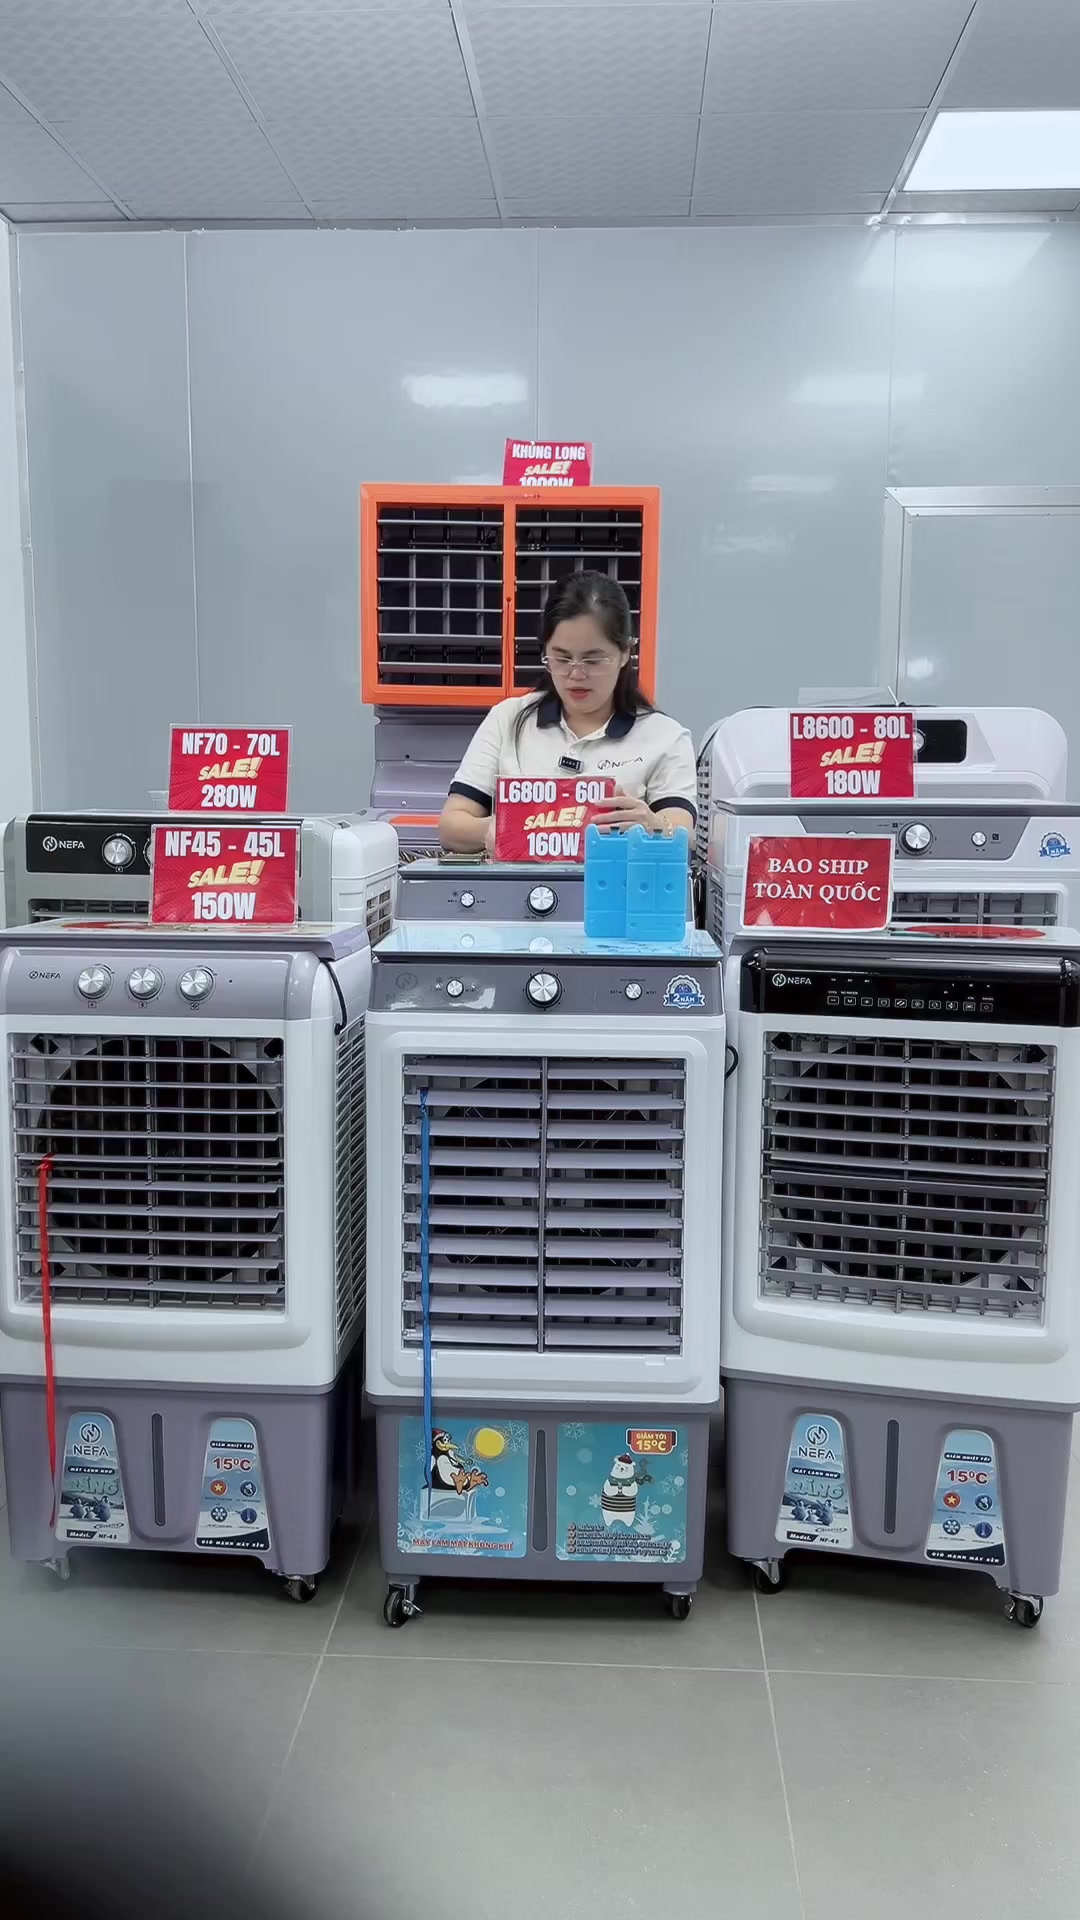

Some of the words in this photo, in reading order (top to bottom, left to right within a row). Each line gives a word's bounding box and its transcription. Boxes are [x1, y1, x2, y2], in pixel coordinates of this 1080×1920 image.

[512, 441, 552, 459] KHỦNG
[555, 446, 586, 460] LONG
[524, 461, 572, 476] SALE!
[793, 716, 854, 739] L8600
[873, 715, 910, 739] 80L
[182, 733, 228, 755] NF70
[247, 733, 280, 755] 70L
[819, 741, 887, 767] SALE!
[198, 757, 263, 781] SALE!
[499, 781, 556, 803] L6800
[824, 770, 880, 795] 180W
[201, 784, 257, 808] 280W
[523, 805, 588, 831] SALE!
[59, 840, 85, 849] NEFA
[165, 831, 221, 857] NF45
[244, 831, 285, 857] 45L
[527, 832, 580, 856] 160W
[187, 860, 265, 889] SALE!
[768, 858, 813, 874] BAO
[818, 859, 869, 875] SHIP
[753, 880, 813, 899] TOÀN
[819, 882, 881, 904] QUỐC
[192, 892, 256, 920] 150W
[787, 977, 812, 985] NEFA
[673, 993, 679, 1002] 2
[73, 1445, 109, 1457] NEFA
[798, 1446, 835, 1460] NEFA
